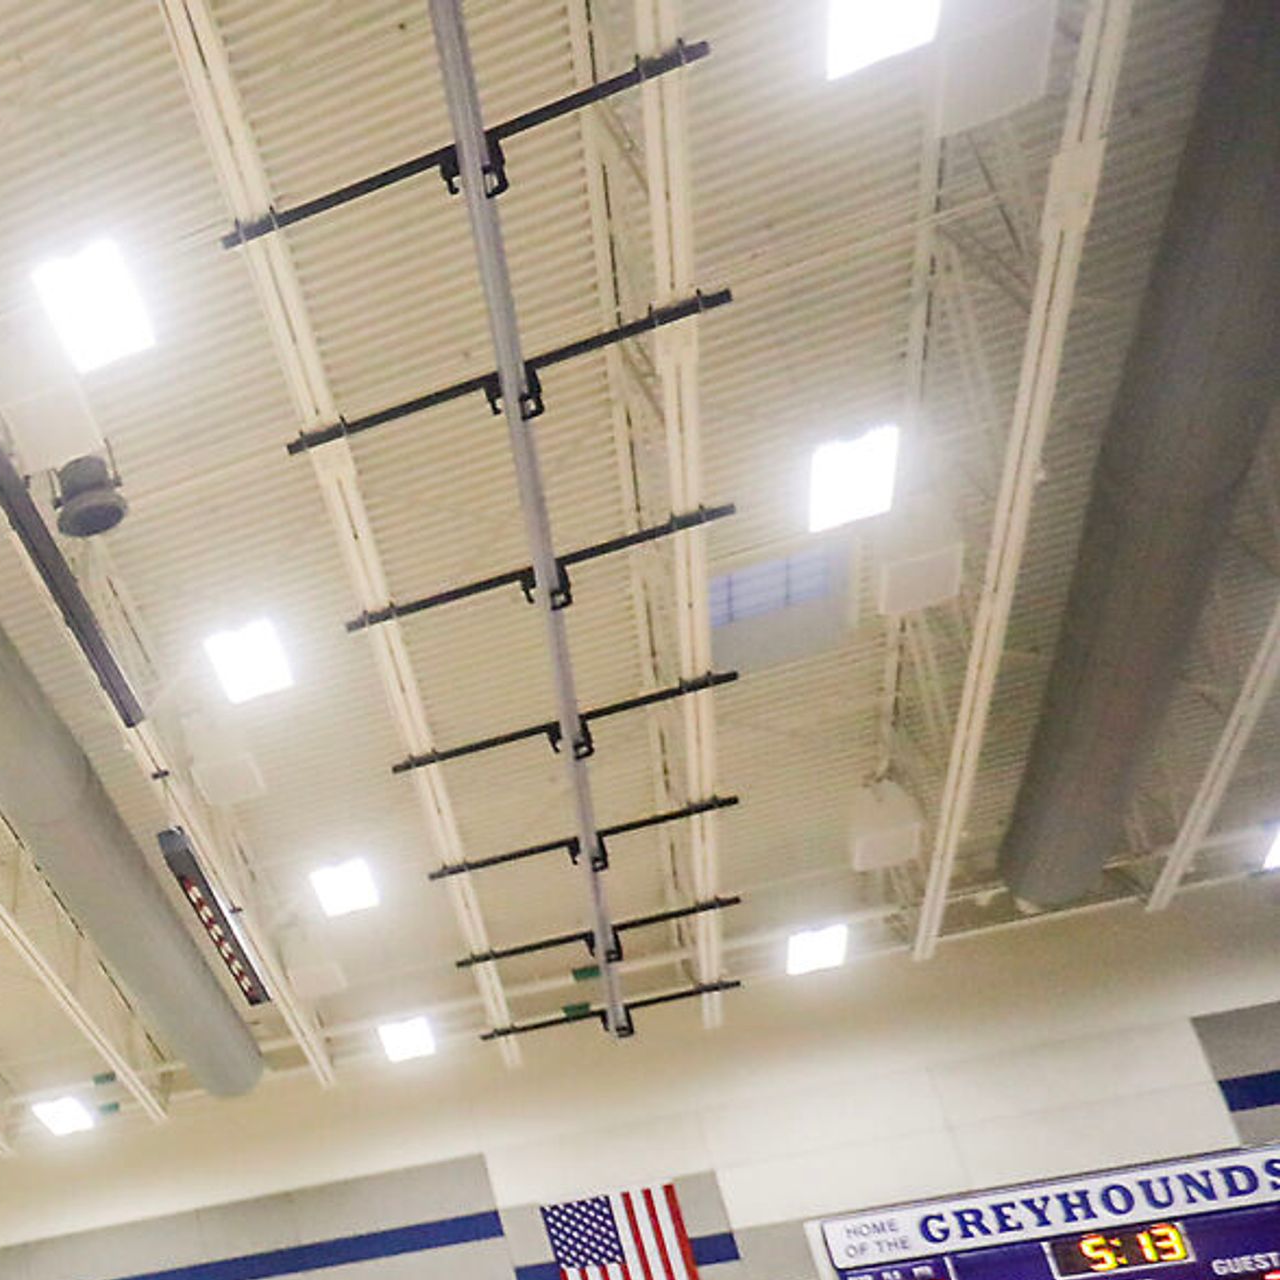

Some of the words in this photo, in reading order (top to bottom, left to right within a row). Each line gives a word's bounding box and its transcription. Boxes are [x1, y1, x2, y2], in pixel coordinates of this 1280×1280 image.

[919, 1158, 1280, 1244] GREYHOUNDS
[846, 1220, 898, 1238] HOME
[846, 1243, 865, 1258] OF
[876, 1238, 909, 1251] THE
[1078, 1223, 1187, 1272] 5:13
